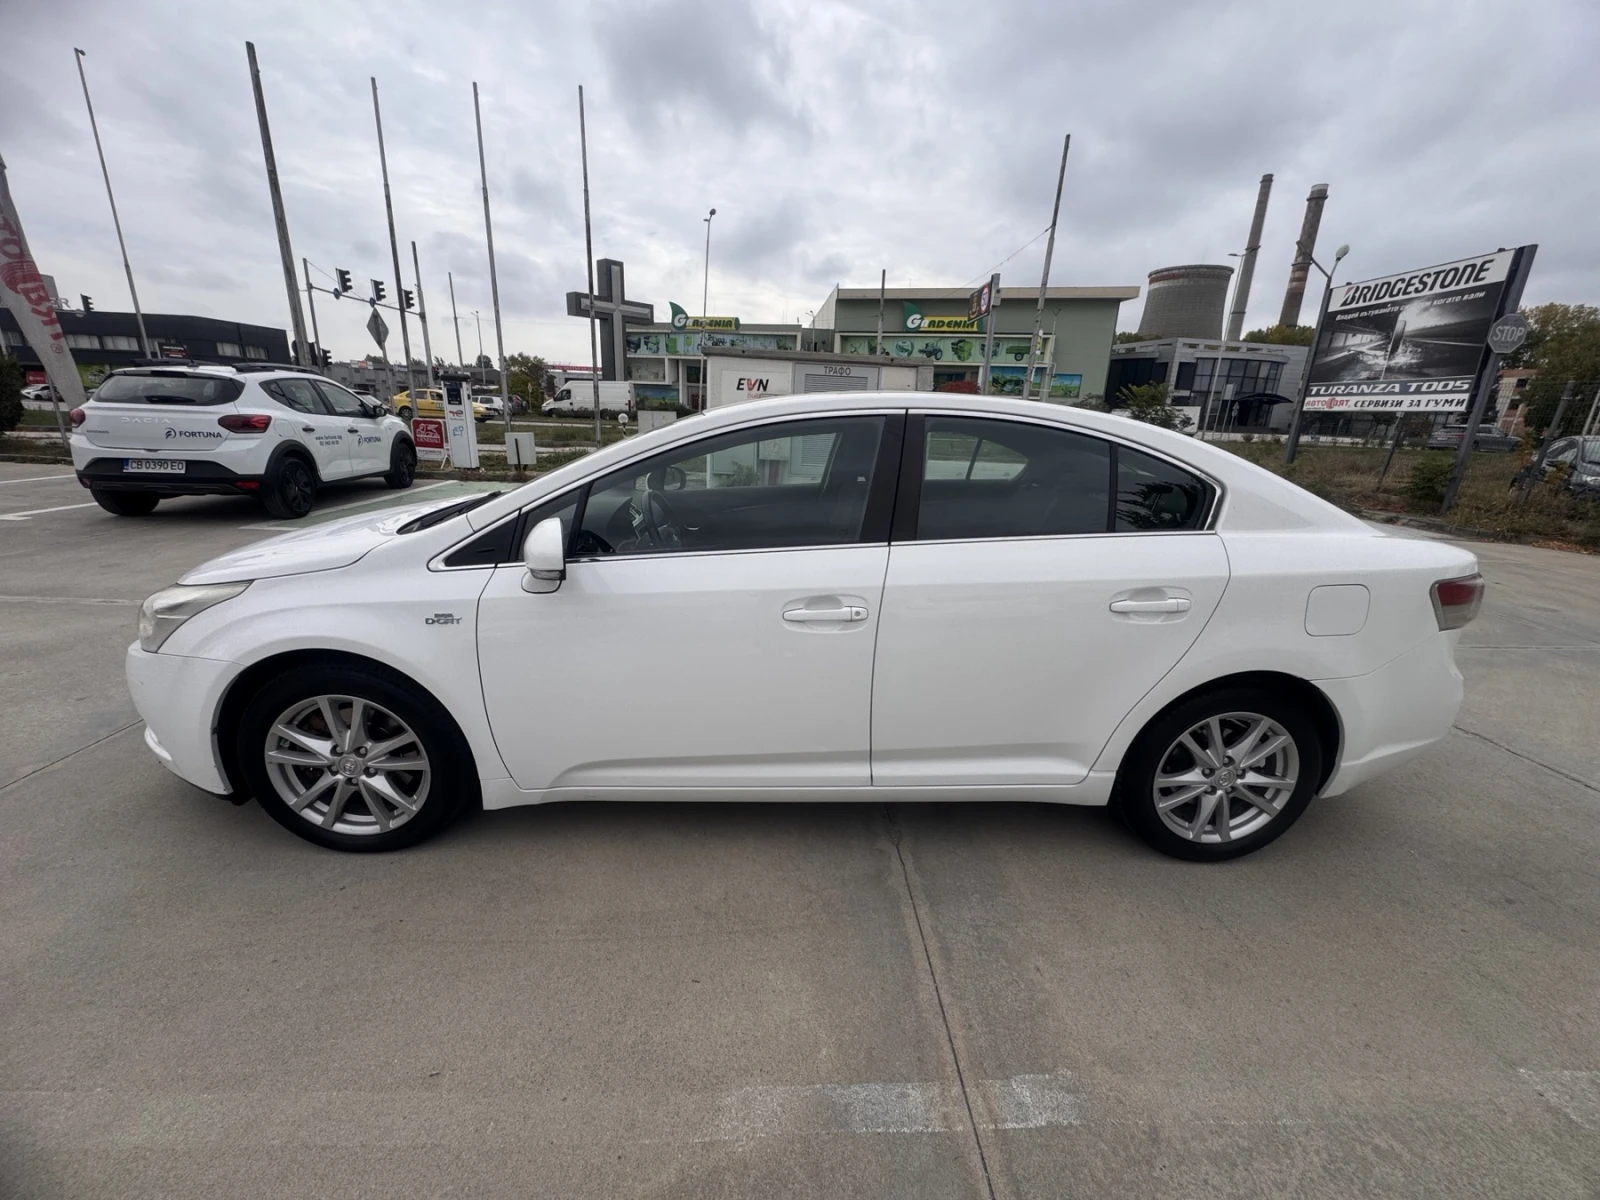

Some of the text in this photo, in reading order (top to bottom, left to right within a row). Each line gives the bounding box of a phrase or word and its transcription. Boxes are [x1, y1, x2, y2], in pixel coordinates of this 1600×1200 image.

[1340, 259, 1495, 308] BRIDGESTONE
[1433, 295, 1462, 306] когато
[1463, 291, 1486, 301] вали
[1493, 325, 1525, 342] STOP
[823, 366, 852, 376] ТРАФО
[736, 377, 769, 392] EVN
[1310, 383, 1400, 395] TURANZA
[1354, 399, 1403, 408] СЕРВИЗИ
[1407, 399, 1420, 408] ЗА
[1425, 398, 1467, 408] ГУМИ
[120, 416, 171, 424] DACIA
[179, 430, 222, 439] FORTUNA
[130, 460, 184, 471] CB 0390 EO
